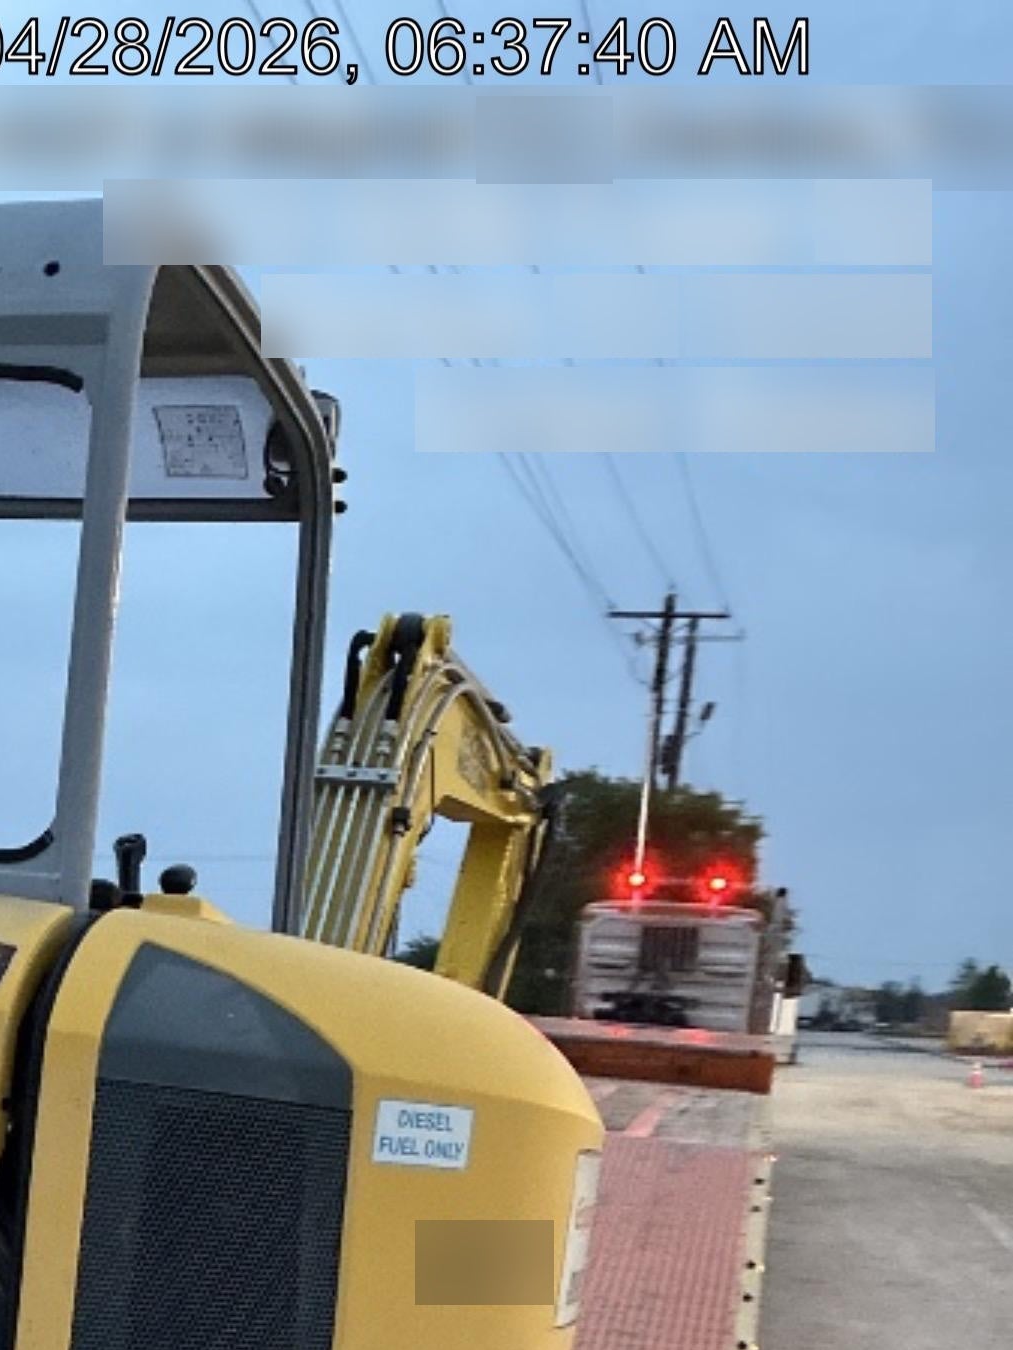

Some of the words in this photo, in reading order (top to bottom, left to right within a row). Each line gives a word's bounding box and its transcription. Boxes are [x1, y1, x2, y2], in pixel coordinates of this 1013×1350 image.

[397, 1109, 453, 1132] DIESEL
[378, 1136, 420, 1156] FUEL
[424, 1139, 465, 1161] ONLY
